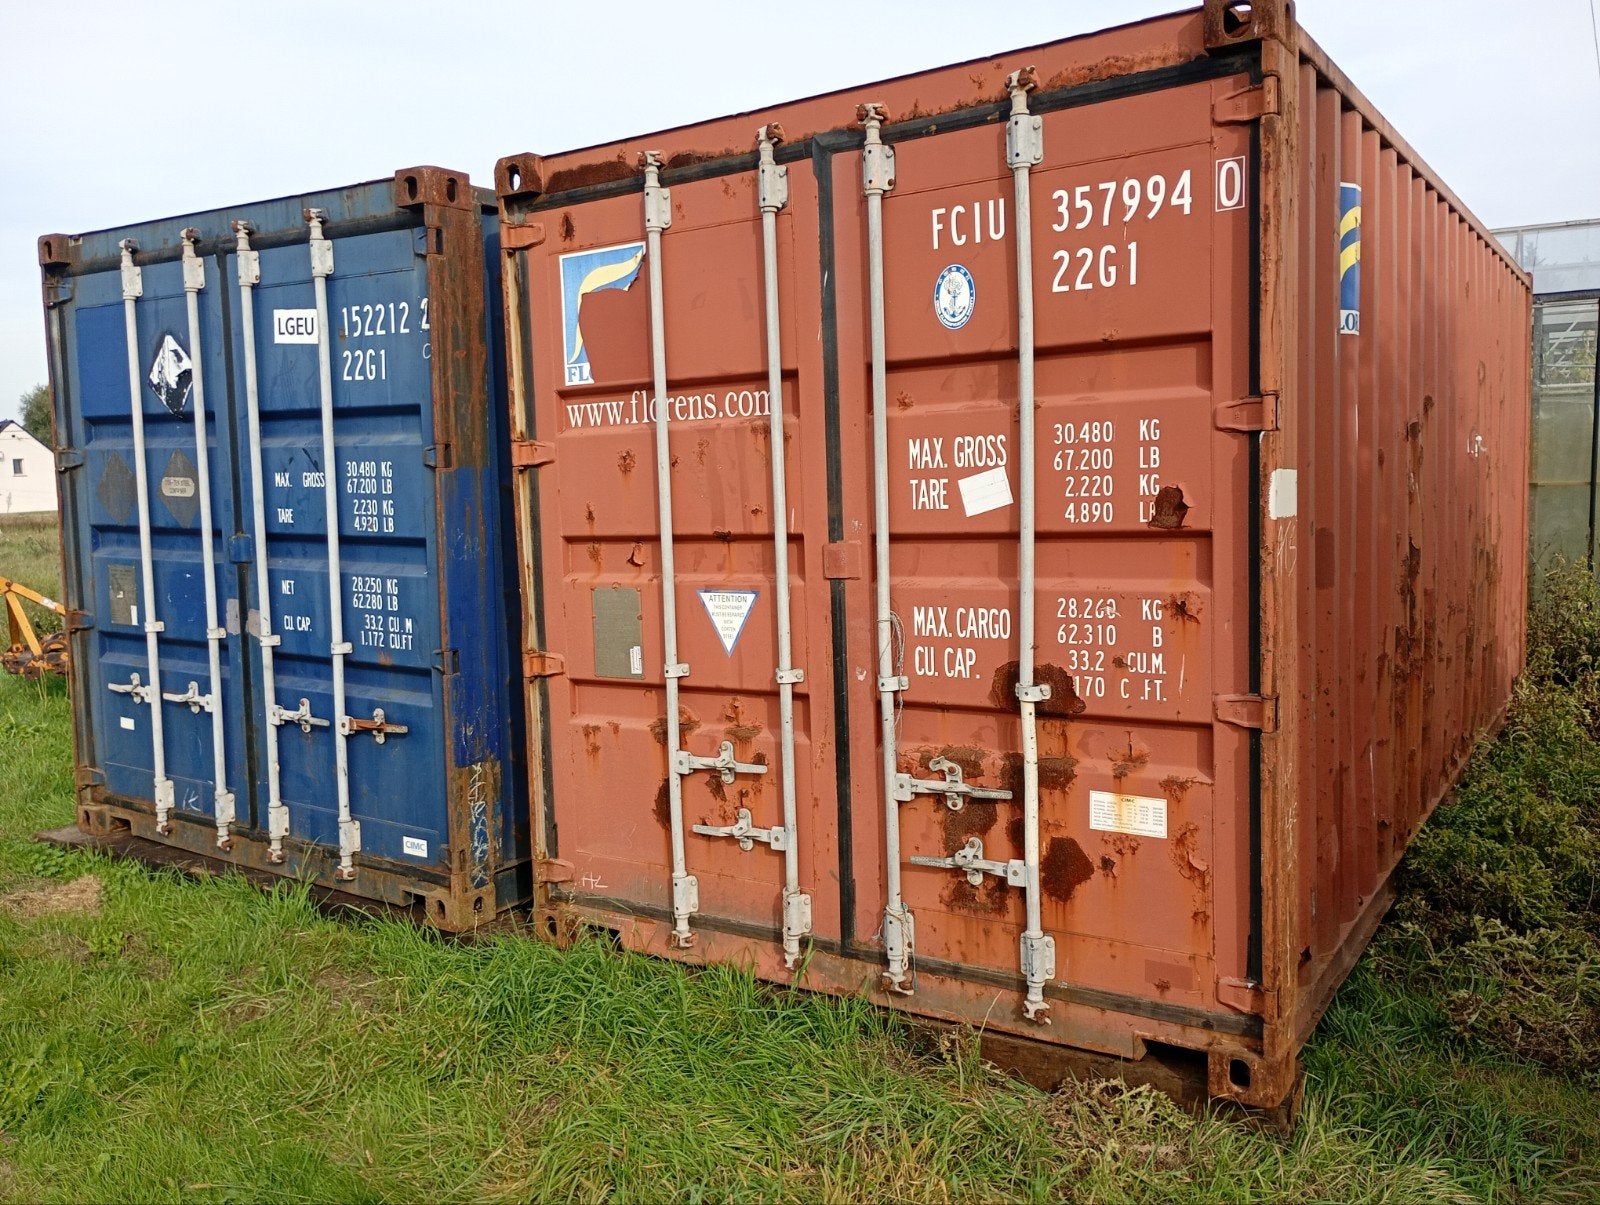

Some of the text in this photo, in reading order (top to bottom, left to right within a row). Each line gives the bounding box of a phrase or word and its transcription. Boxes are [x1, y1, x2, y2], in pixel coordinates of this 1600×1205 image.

[933, 161, 1241, 249] FCIU 357994 0
[1053, 242, 1136, 292] 22G1
[278, 317, 314, 336] LGEU
[342, 302, 409, 337] 152212
[343, 349, 385, 380] 22G1
[567, 366, 590, 383] FL
[566, 388, 771, 429] www.florens.com
[909, 419, 1159, 469] MAX. GROSS 30,480 KG
[1054, 447, 1159, 470] 67,200 LB
[275, 473, 292, 487] MAX.
[303, 471, 325, 487] GROSS
[381, 462, 392, 477] KG
[382, 479, 392, 494] LB
[910, 474, 1159, 509] TARE 2,220 KG
[278, 509, 293, 523] TARE
[383, 500, 393, 515] KG
[1065, 502, 1112, 522] 4,890
[384, 517, 394, 532] LB
[282, 580, 294, 594] NET
[387, 579, 398, 594] KG
[388, 596, 398, 611] LB
[709, 595, 748, 603] ATTENTION
[297, 616, 312, 631] CAP.
[365, 614, 383, 630] 33.2
[914, 607, 952, 637] MAX.
[957, 608, 1010, 639] CARGO
[1143, 600, 1162, 620] KG
[1058, 624, 1116, 645] 62,310
[915, 646, 938, 676] CU.
[945, 648, 979, 678] CAP.
[1069, 650, 1104, 671] 33.2
[405, 840, 425, 852] CIMC
